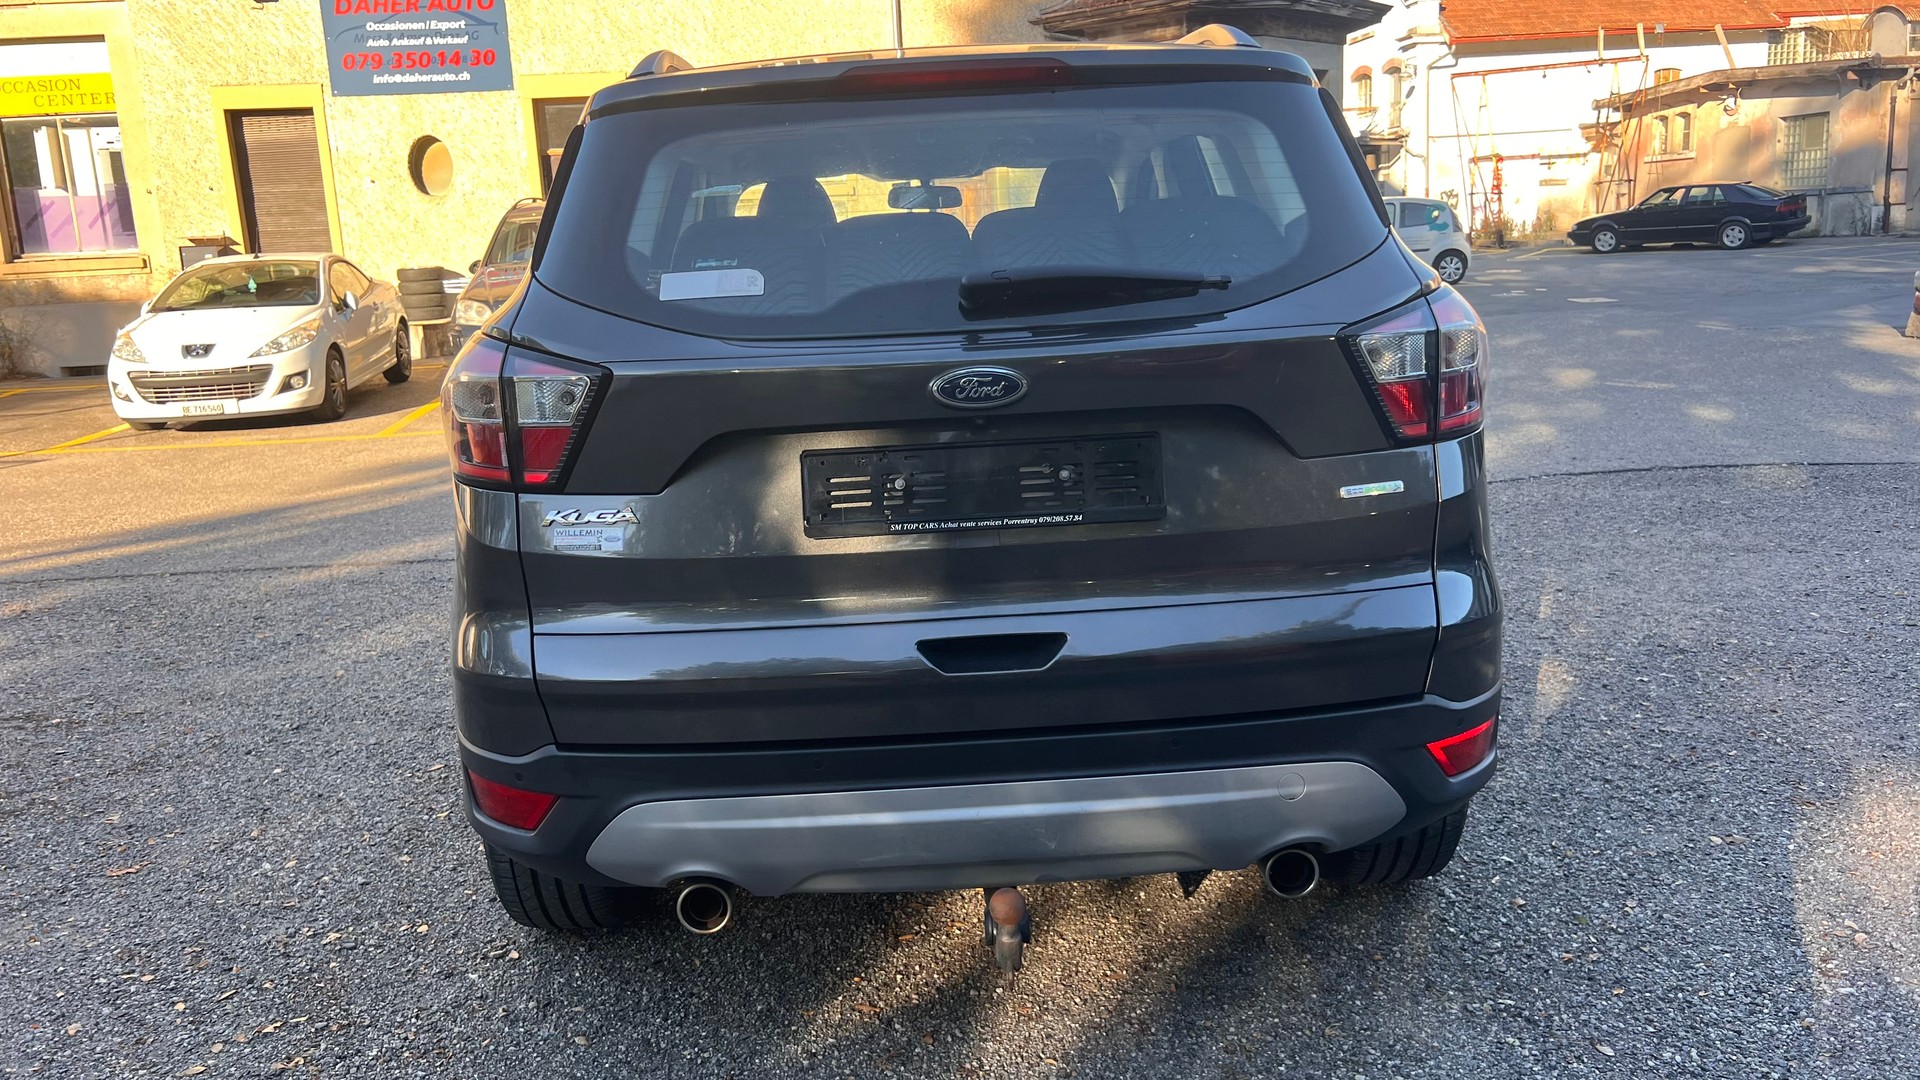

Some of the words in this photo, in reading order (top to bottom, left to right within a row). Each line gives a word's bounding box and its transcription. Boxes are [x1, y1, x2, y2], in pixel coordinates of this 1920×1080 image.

[334, 0, 421, 16] DAHER
[425, 0, 496, 13] AUTO
[366, 21, 425, 31] Occasionen
[430, 20, 465, 31] Export
[366, 38, 390, 47] Auto
[391, 37, 425, 46] Ankauf
[425, 37, 433, 45] &
[433, 35, 469, 45] Verkauf
[342, 52, 384, 71] 079
[390, 50, 432, 69] 350
[436, 49, 461, 68] 14
[468, 48, 497, 67] 30
[373, 71, 471, 84] info@daherauto.ch
[0, 79, 81, 94] CCASION
[33, 92, 116, 108] CENTER
[955, 377, 1009, 399] Ford
[541, 507, 640, 527] KUGA
[890, 523, 902, 531] SM
[903, 522, 919, 530] TOP
[919, 521, 939, 530] CARS
[939, 520, 959, 529] Achat
[960, 520, 977, 528] vente
[977, 518, 1002, 527] services
[1003, 517, 1038, 526] Porrentruy
